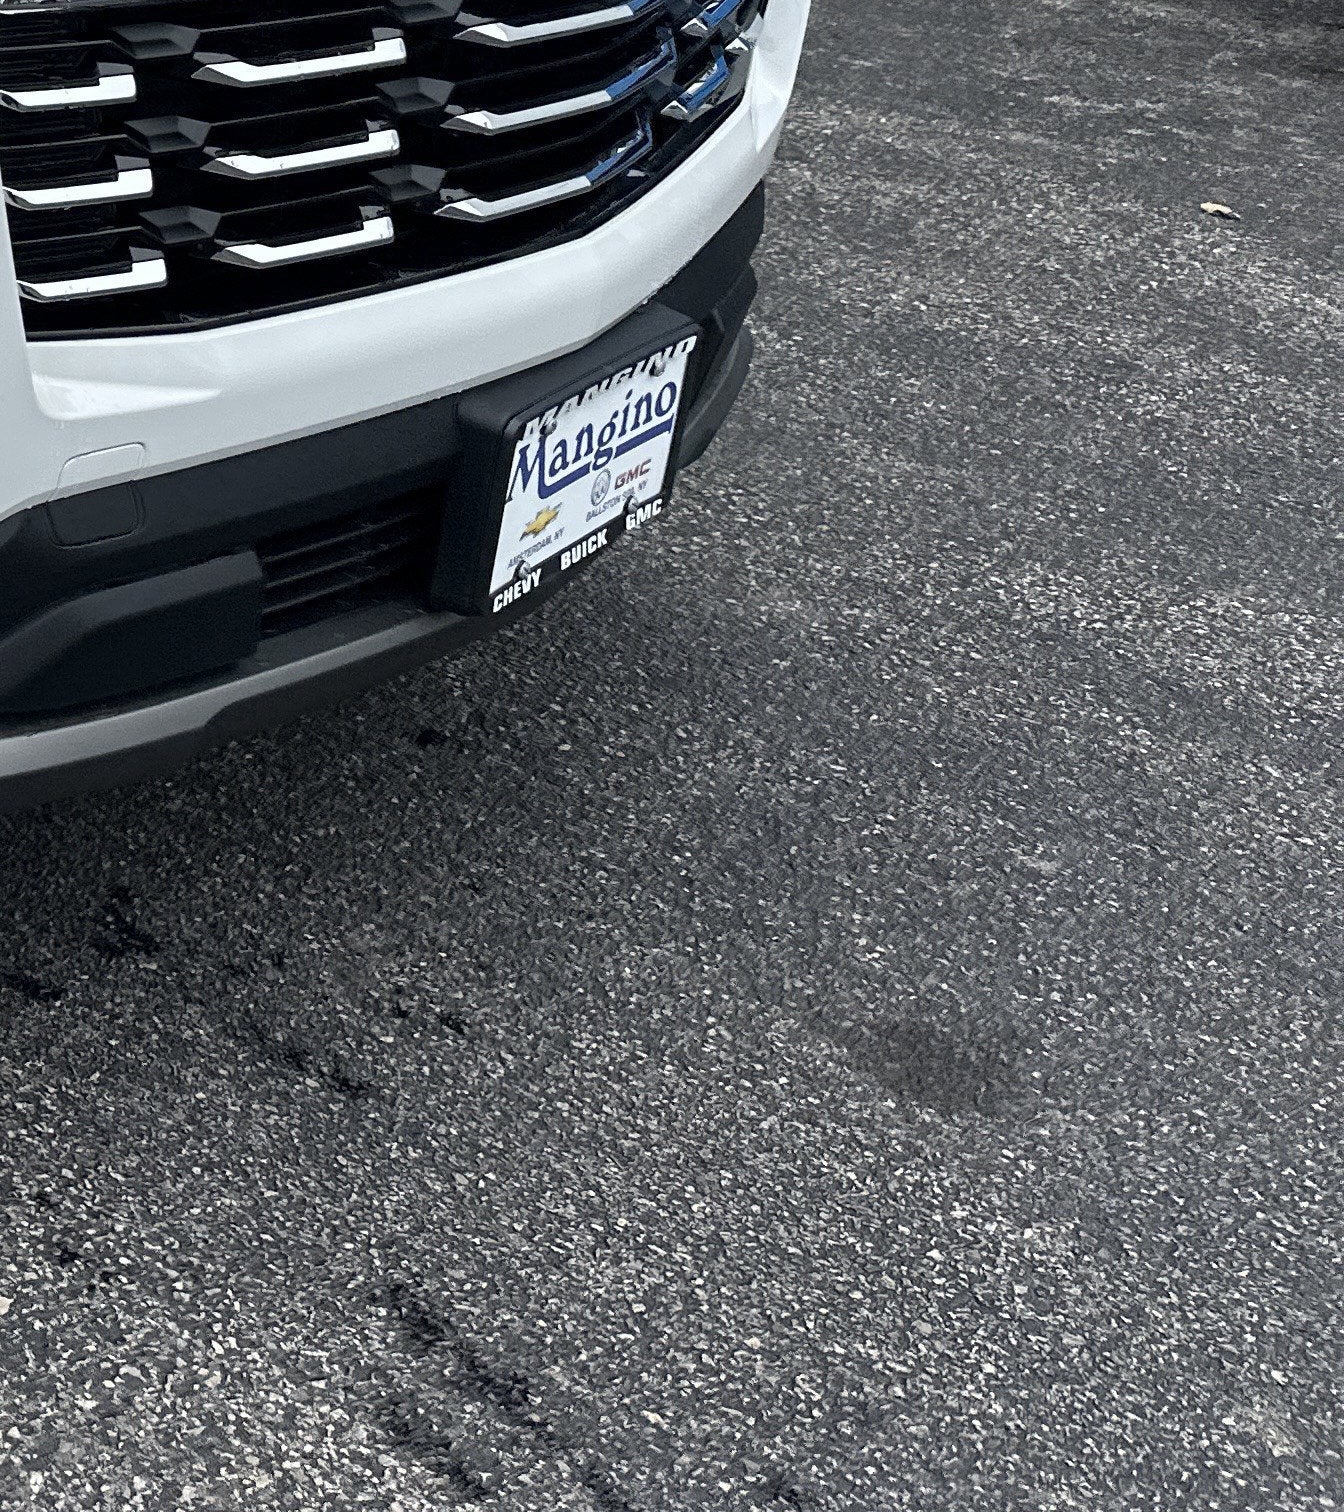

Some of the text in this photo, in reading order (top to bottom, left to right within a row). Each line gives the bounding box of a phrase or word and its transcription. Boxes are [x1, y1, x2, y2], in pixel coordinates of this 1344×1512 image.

[506, 381, 678, 499] Mangino
[523, 335, 697, 441] MANGINO
[614, 459, 652, 490] GMC
[493, 498, 662, 613] CHEVY BUICK GMC
